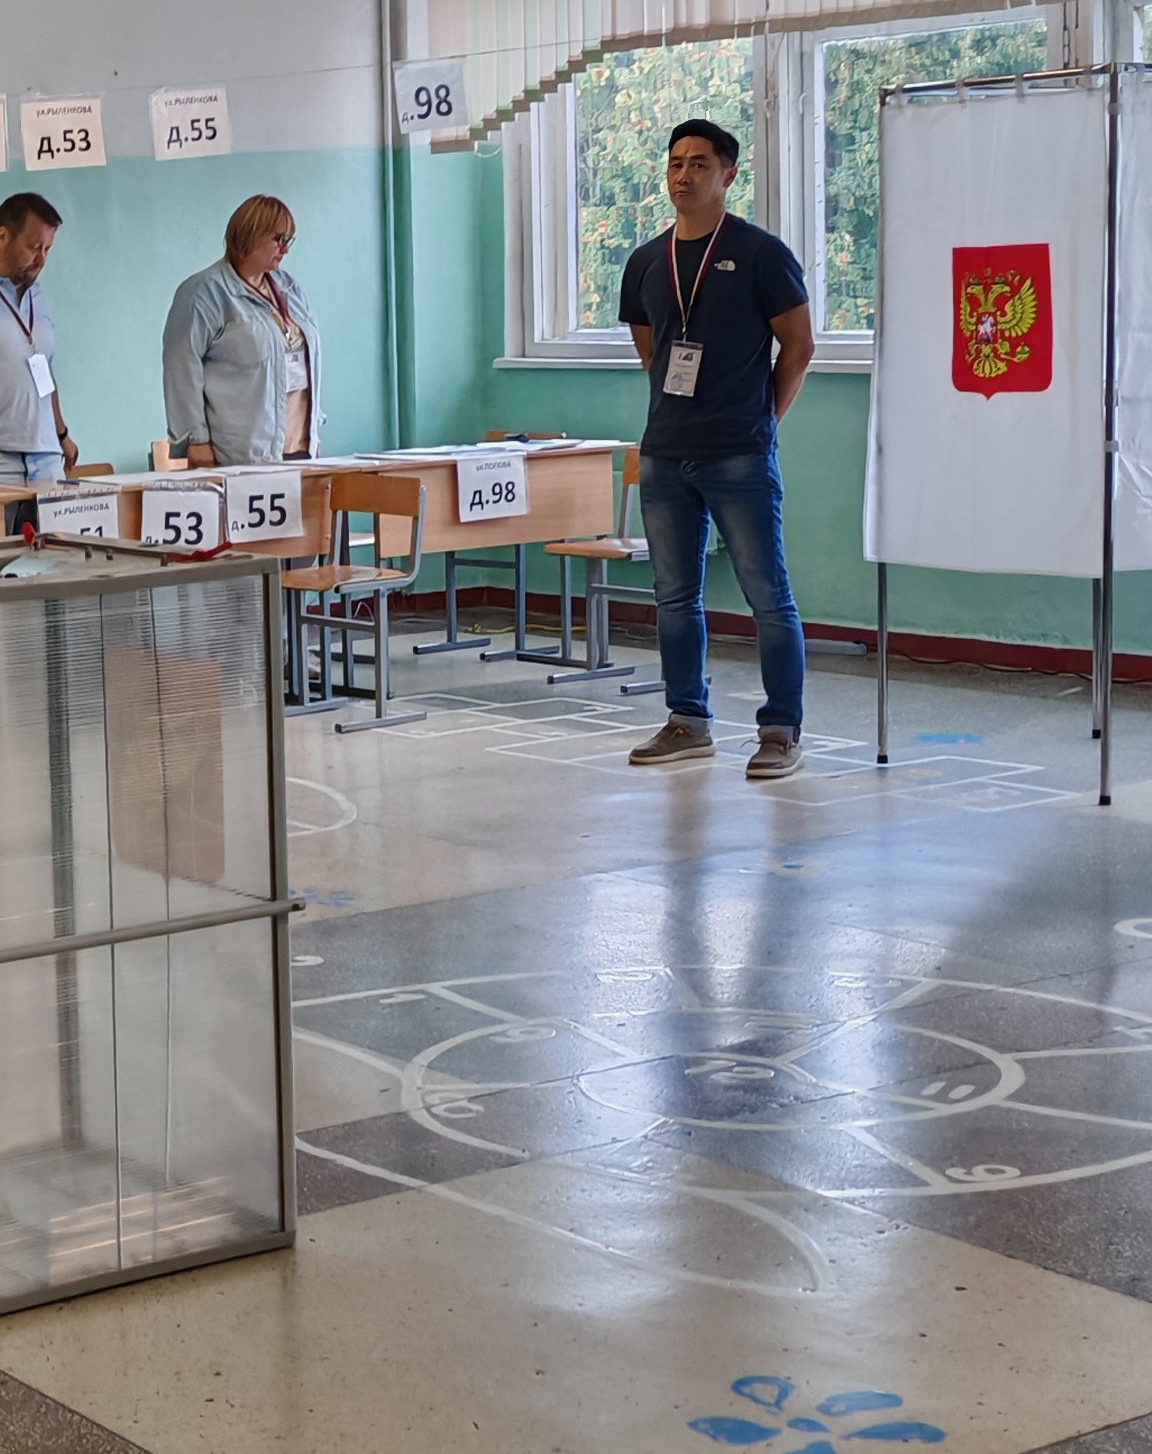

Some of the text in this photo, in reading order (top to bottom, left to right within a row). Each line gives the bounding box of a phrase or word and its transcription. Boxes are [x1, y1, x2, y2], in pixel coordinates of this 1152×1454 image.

[402, 84, 453, 124] д.98
[37, 128, 91, 160] д.53
[167, 117, 217, 150] д.55
[231, 493, 287, 533] д.55
[470, 481, 516, 512] д.98
